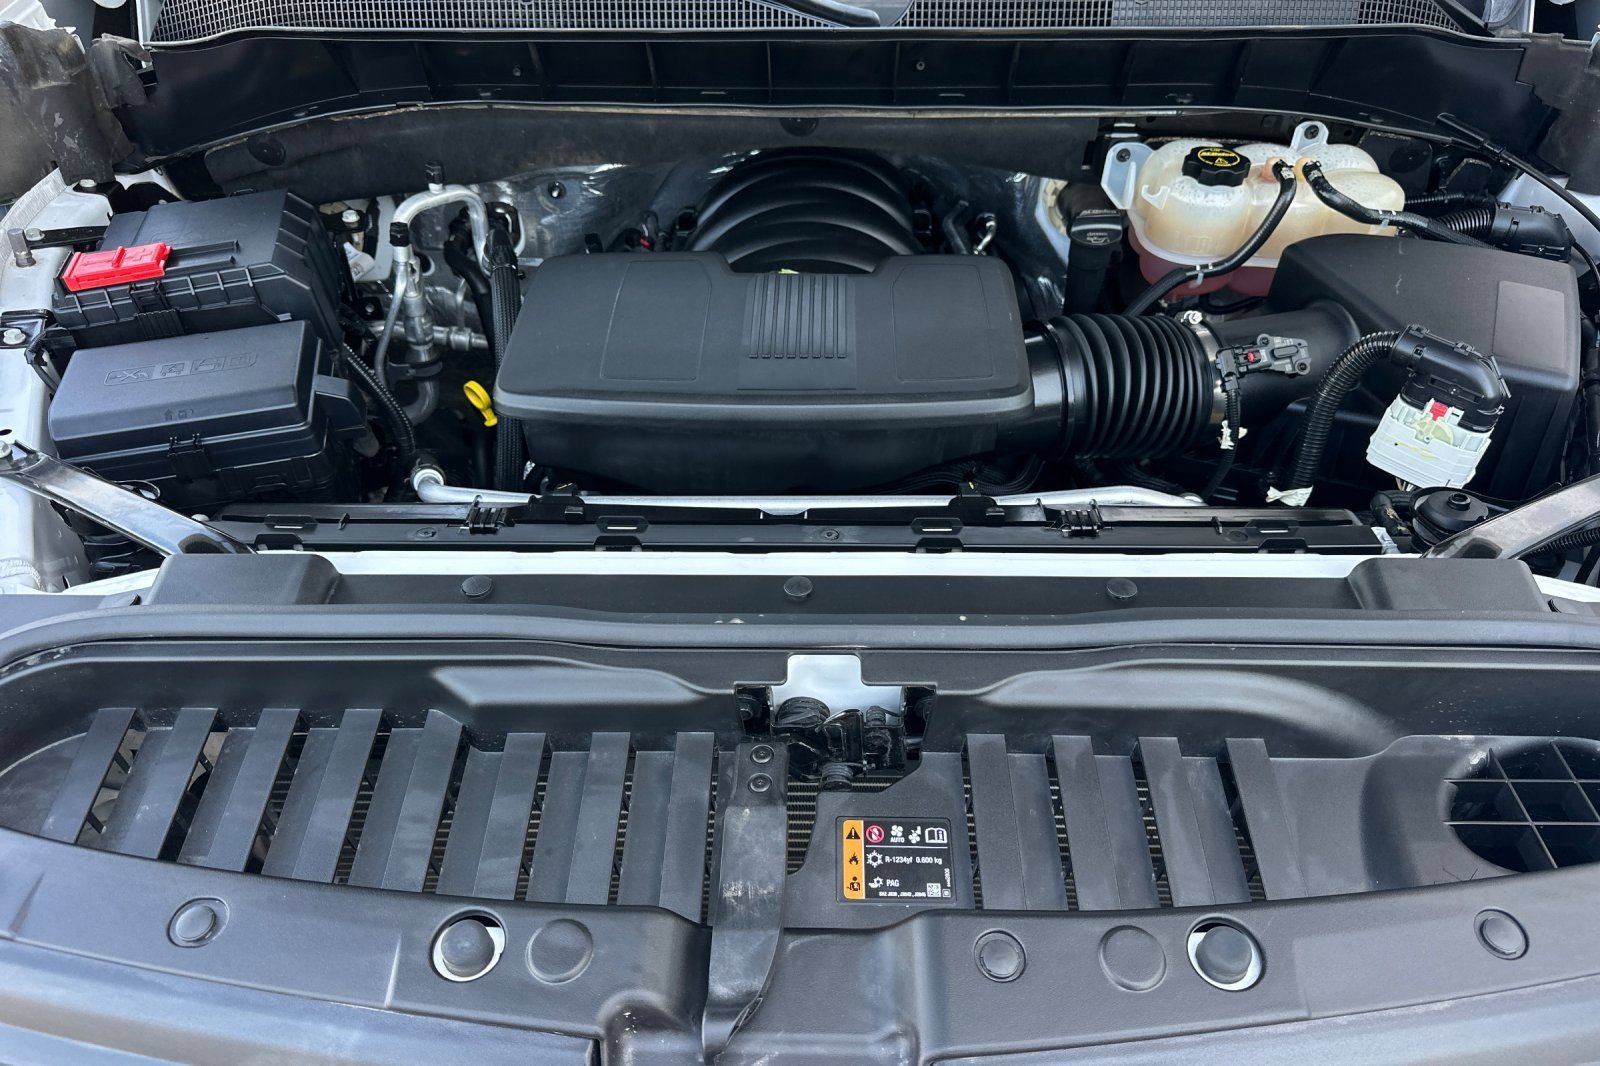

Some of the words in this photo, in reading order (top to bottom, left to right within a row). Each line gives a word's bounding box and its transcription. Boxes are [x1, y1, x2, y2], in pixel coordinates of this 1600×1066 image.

[885, 856, 913, 864] R-1234yf
[934, 857, 943, 865] kg
[886, 879, 899, 887] PAG
